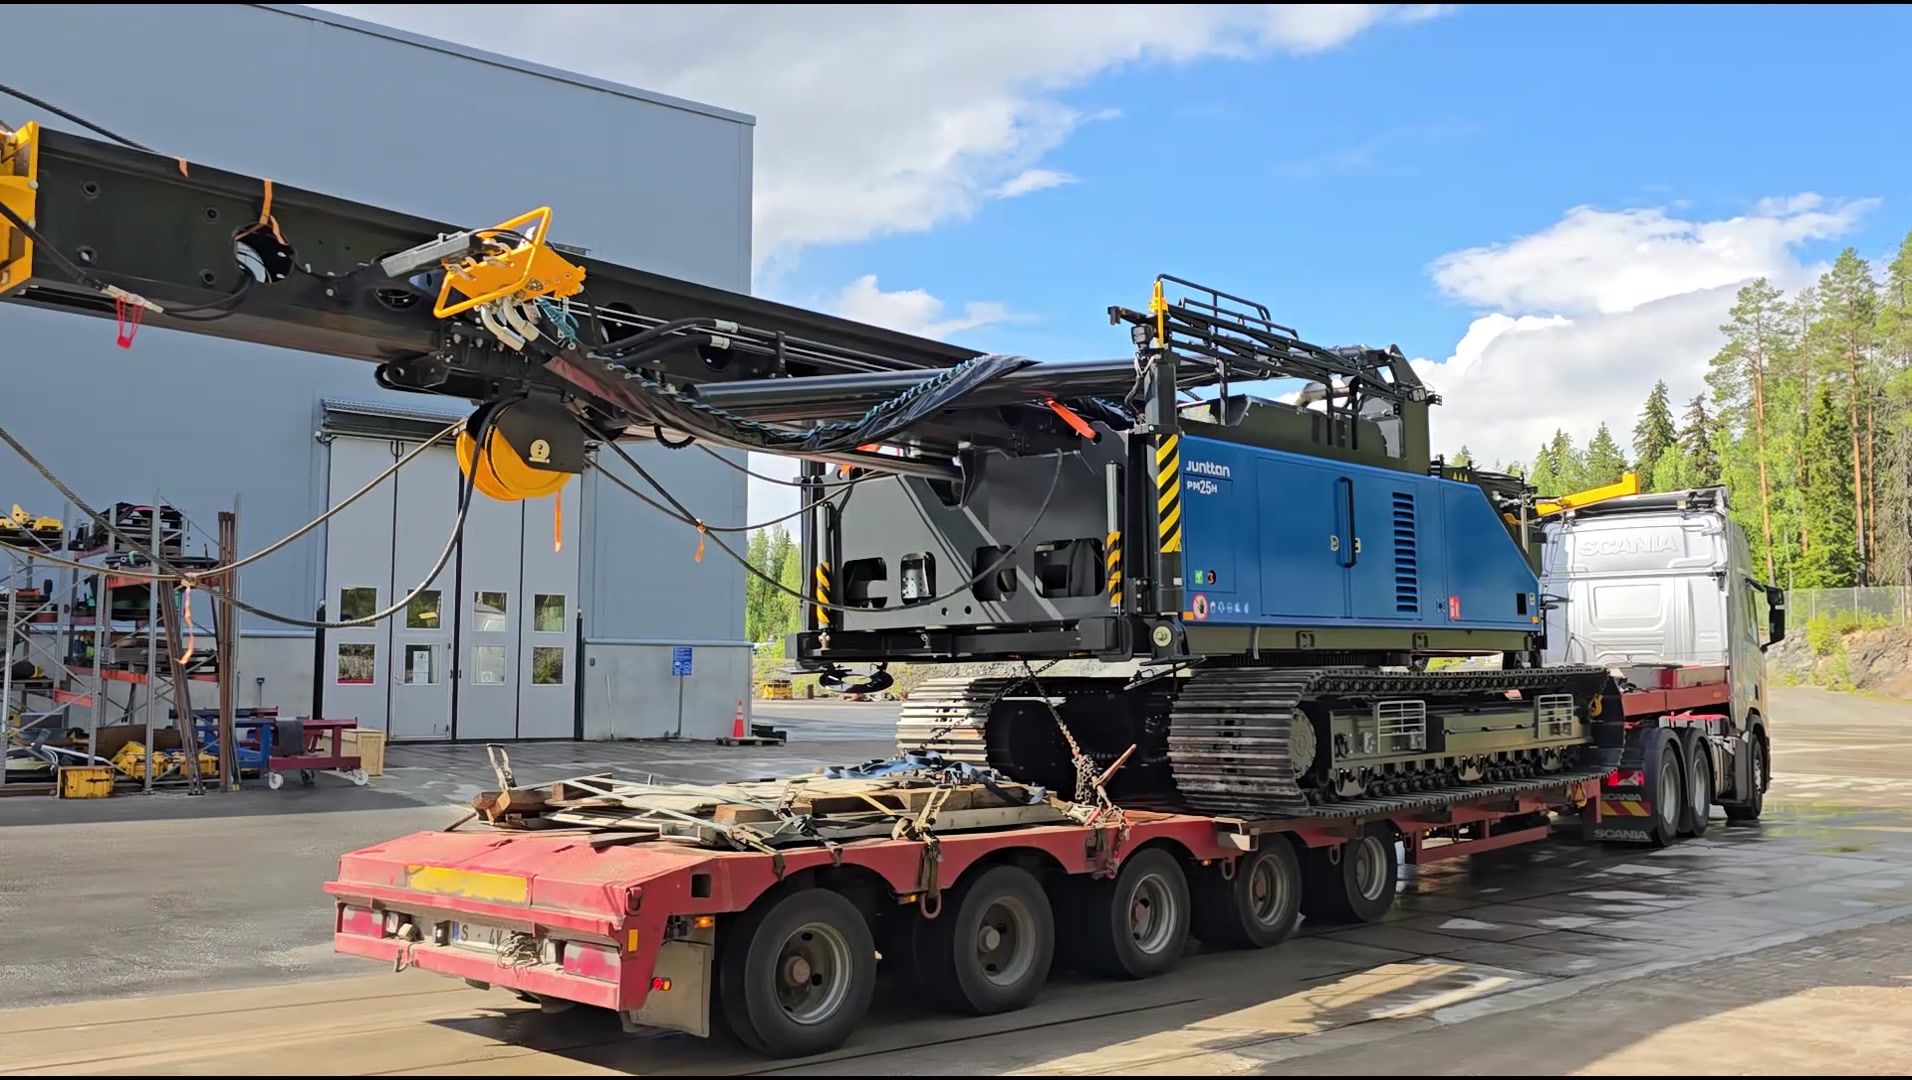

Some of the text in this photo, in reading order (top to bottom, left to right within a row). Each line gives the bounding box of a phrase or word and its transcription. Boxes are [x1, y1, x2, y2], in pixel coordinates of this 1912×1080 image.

[1186, 460, 1231, 478] Junttan
[1187, 479, 1218, 495] PM25H
[1579, 535, 1679, 557] SCANIA
[1594, 829, 1650, 840] SCANIA
